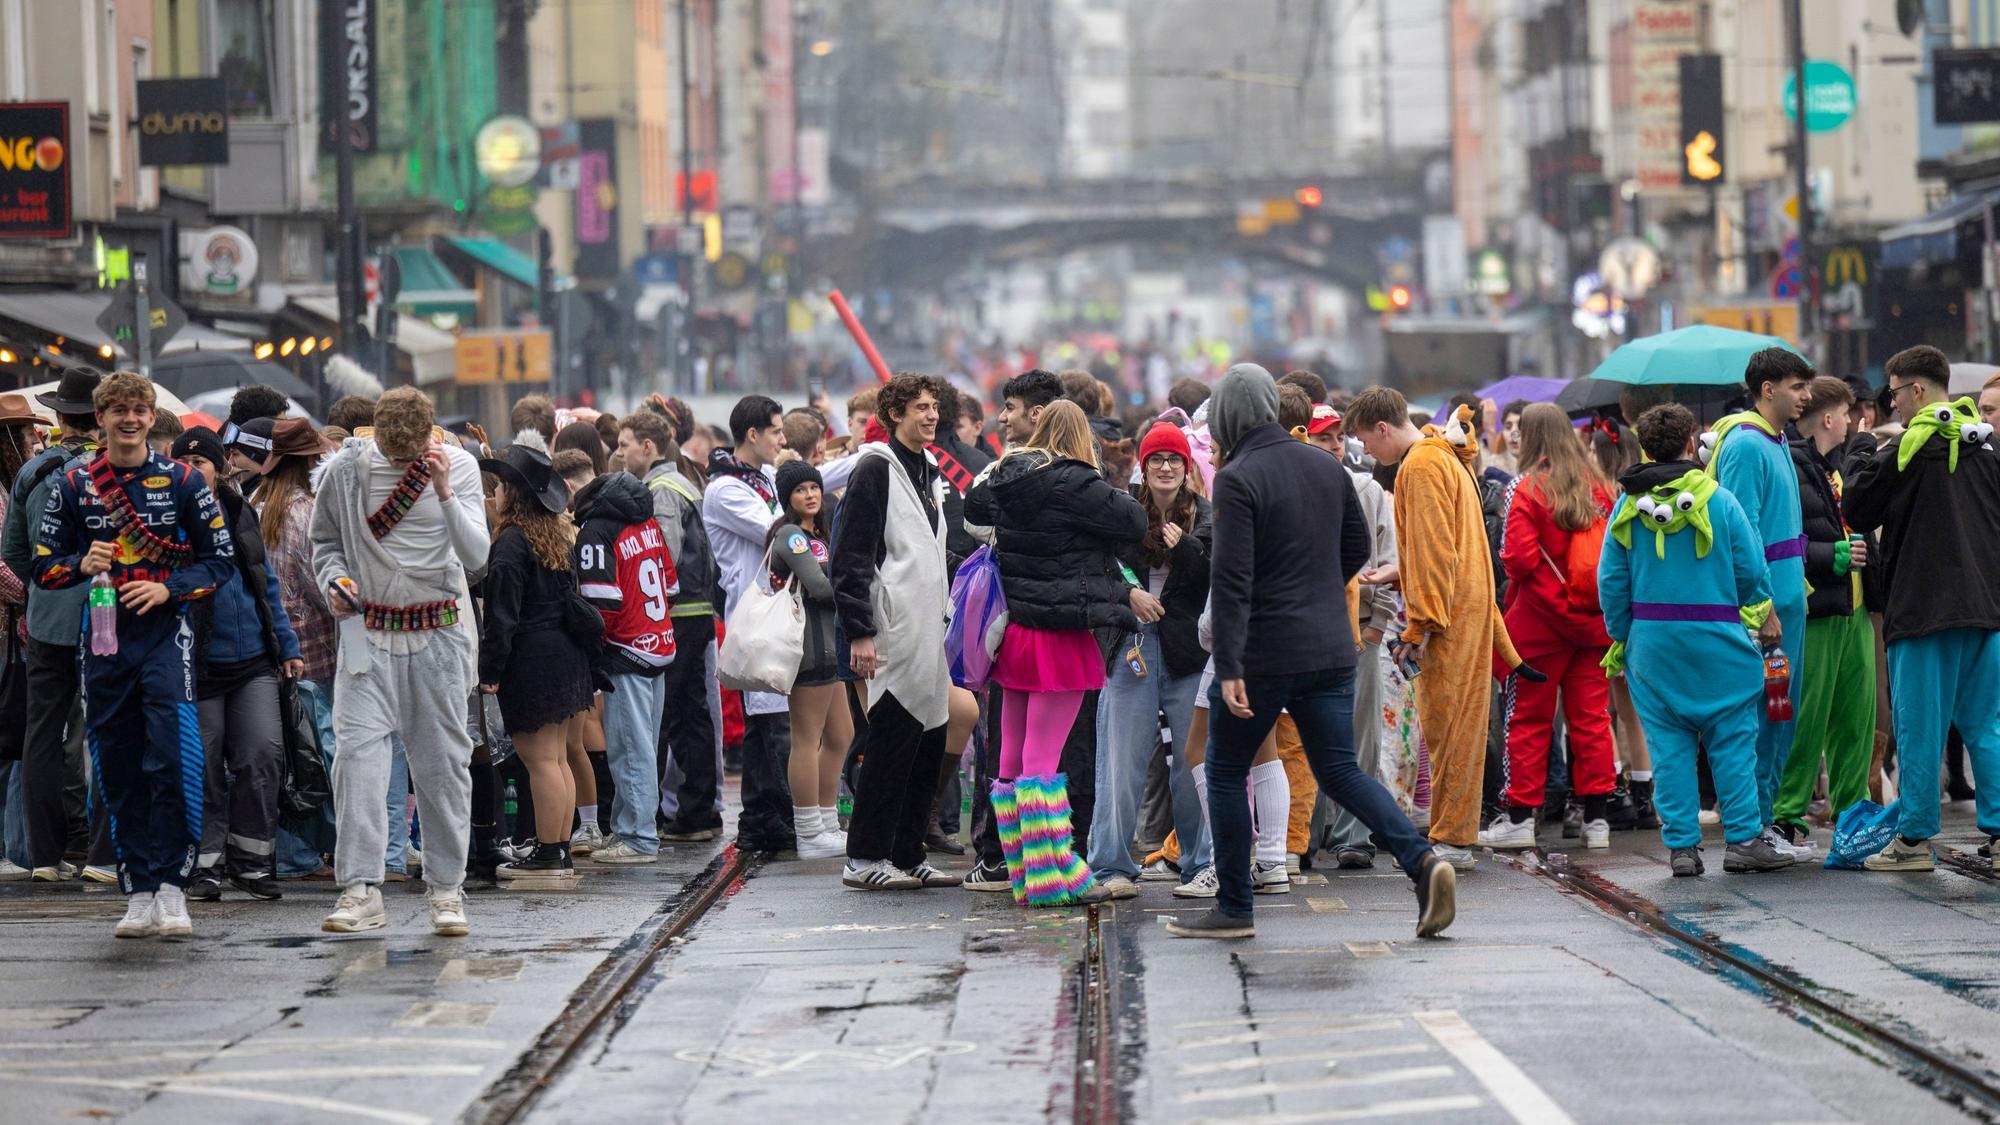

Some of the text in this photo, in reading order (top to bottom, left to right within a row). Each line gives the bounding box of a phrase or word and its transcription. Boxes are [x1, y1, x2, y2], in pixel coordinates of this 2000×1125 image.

[143, 111, 225, 135] duma
[146, 491, 171, 501] BYBIT
[85, 511, 176, 529] ORCLE
[580, 543, 605, 570] 91
